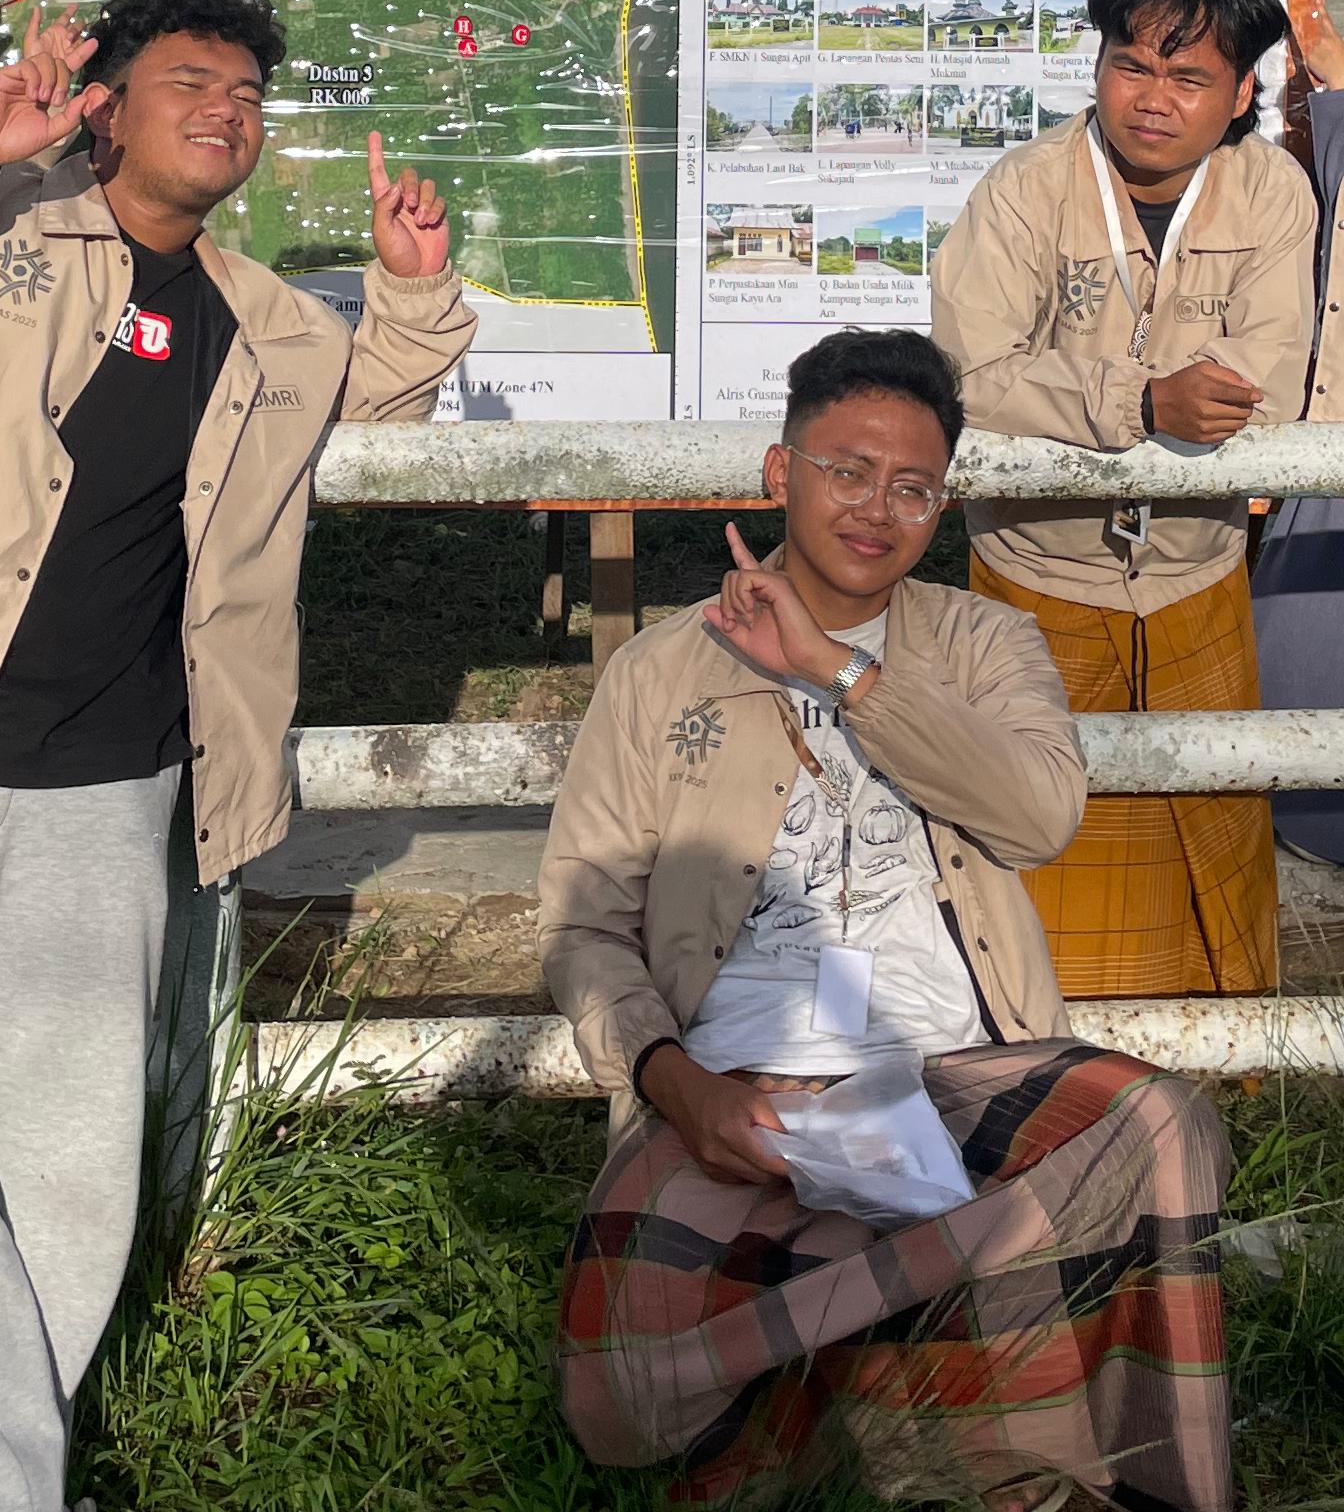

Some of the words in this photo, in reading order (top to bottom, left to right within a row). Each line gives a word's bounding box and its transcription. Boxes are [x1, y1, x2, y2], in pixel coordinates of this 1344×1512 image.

[720, 53, 750, 62] SMKN
[760, 53, 790, 64] Sungai
[792, 54, 811, 65] Apit
[831, 54, 873, 65] Laangan
[308, 65, 362, 82] Dusun
[311, 88, 340, 105] RK
[720, 162, 764, 173] Pelabuhan
[709, 293, 739, 304] Sungai
[741, 294, 764, 304] Kayu
[766, 294, 782, 303] Ara
[896, 295, 919, 306] Kayu
[819, 309, 836, 319] Ara
[12, 313, 39, 329] 2025
[458, 381, 492, 393] UTM
[495, 381, 526, 393] Zone
[529, 381, 554, 393] 47N
[716, 388, 745, 401] Alris
